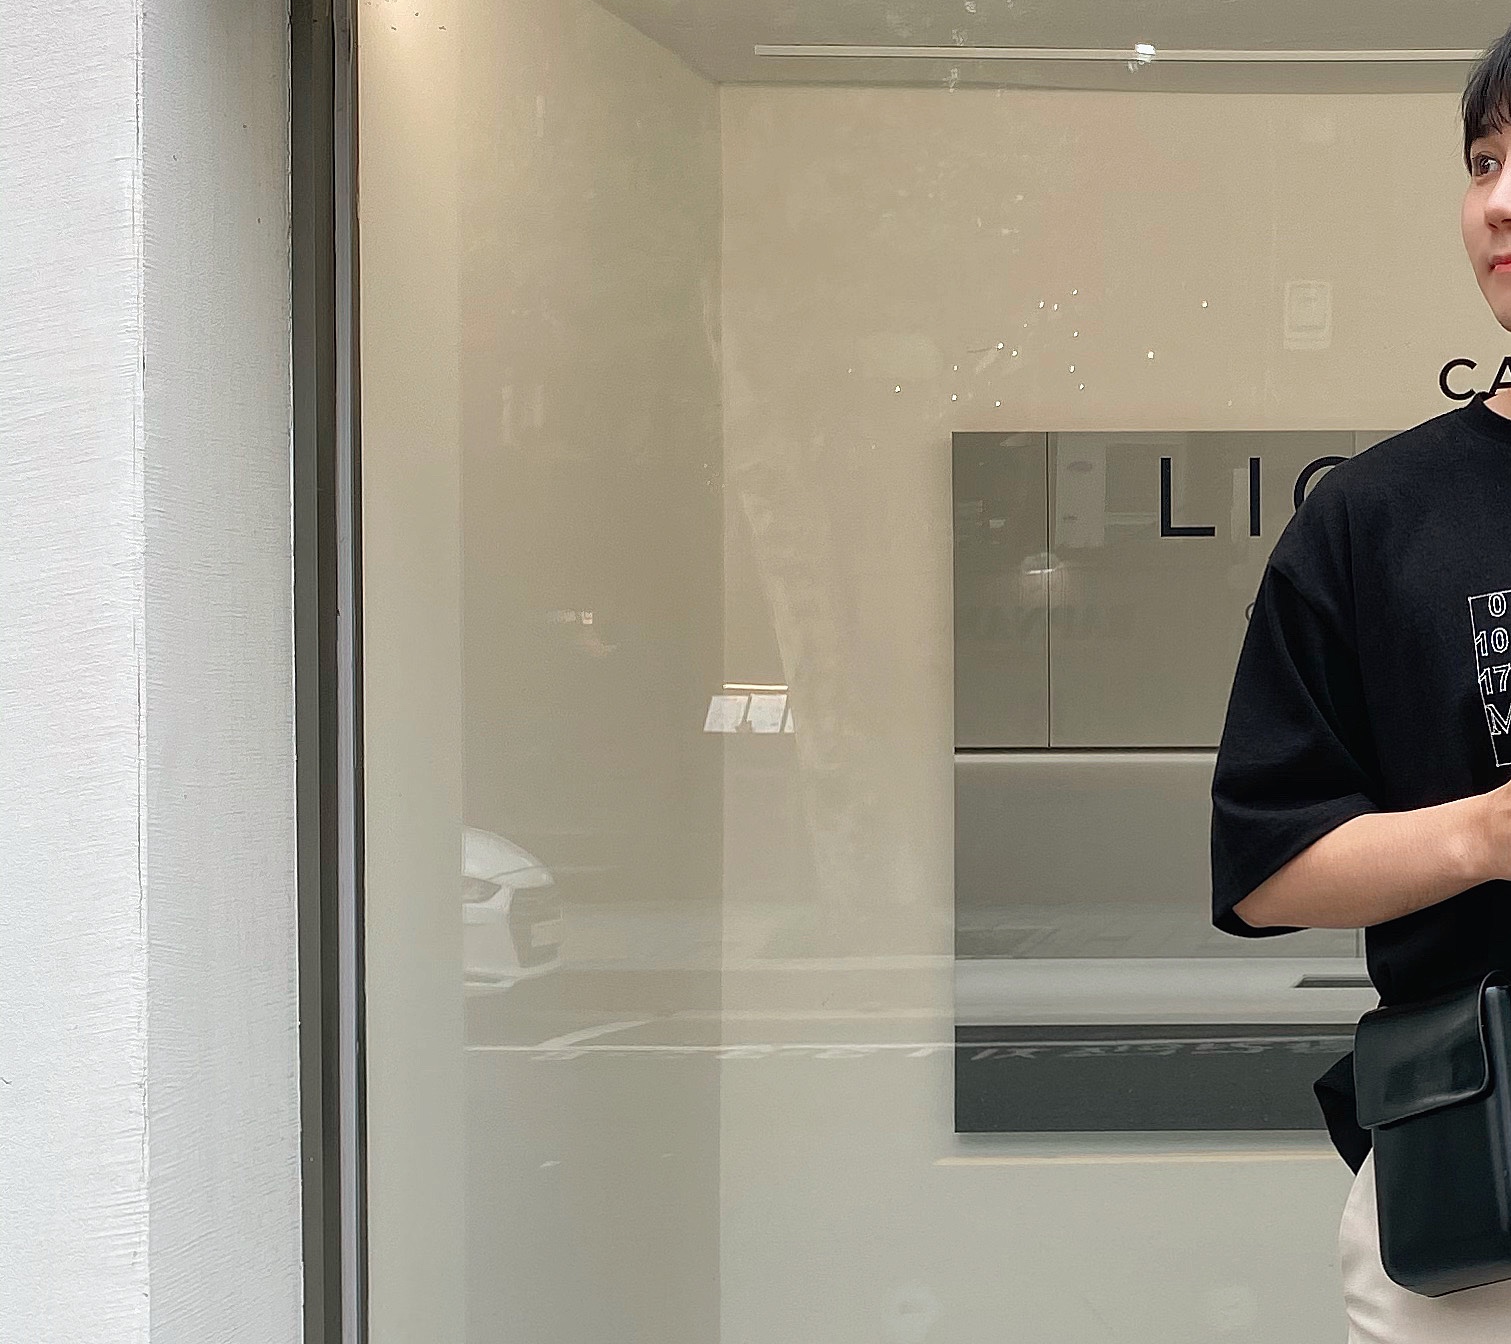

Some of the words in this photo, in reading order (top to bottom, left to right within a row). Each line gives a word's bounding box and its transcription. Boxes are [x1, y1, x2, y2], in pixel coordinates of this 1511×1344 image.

[1487, 592, 1507, 618] 0
[1474, 629, 1510, 657] 10
[1478, 662, 1511, 696] 17
